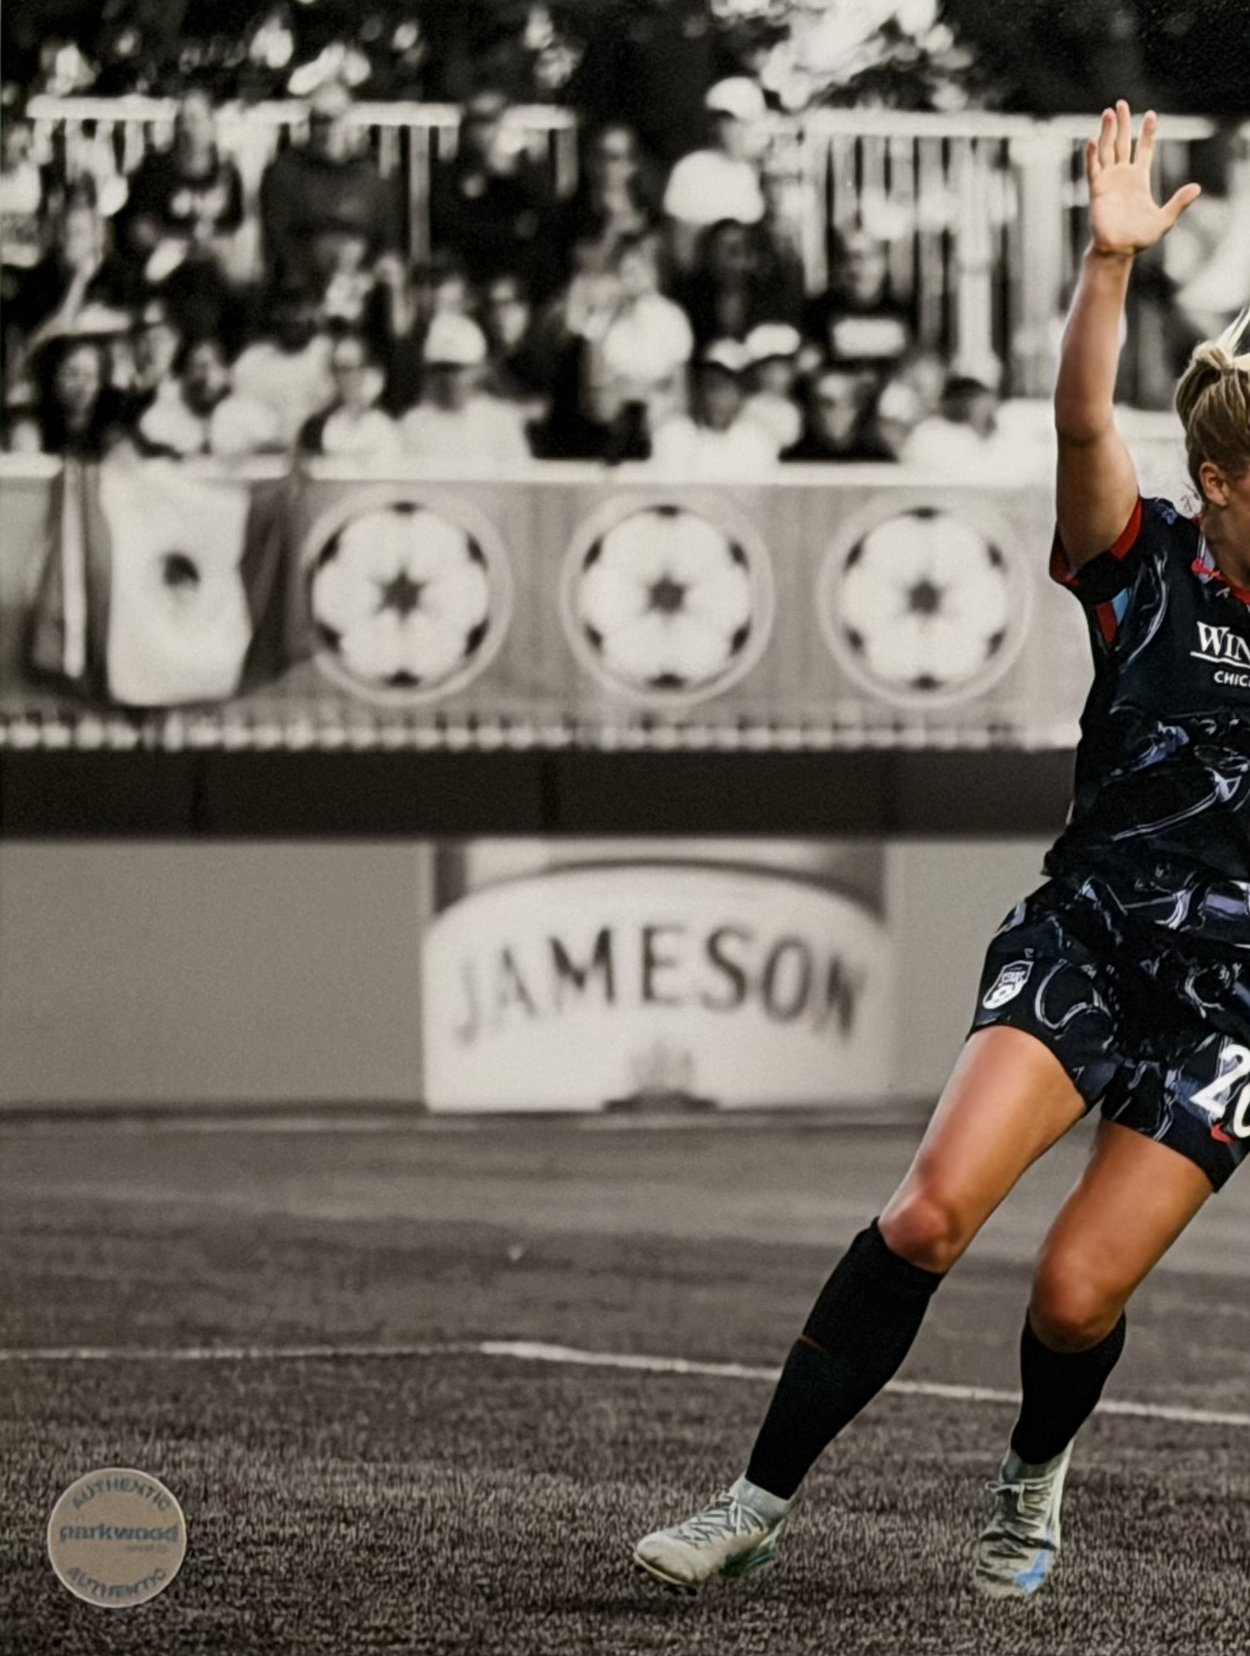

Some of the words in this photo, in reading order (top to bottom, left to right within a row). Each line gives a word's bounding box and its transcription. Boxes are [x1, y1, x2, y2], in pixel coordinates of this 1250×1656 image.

[454, 925, 866, 1046] JAMESON
[72, 1478, 171, 1511] AUTHENTIC
[59, 1522, 179, 1543] parkwood
[66, 1566, 167, 1598] AUTHENTIC
